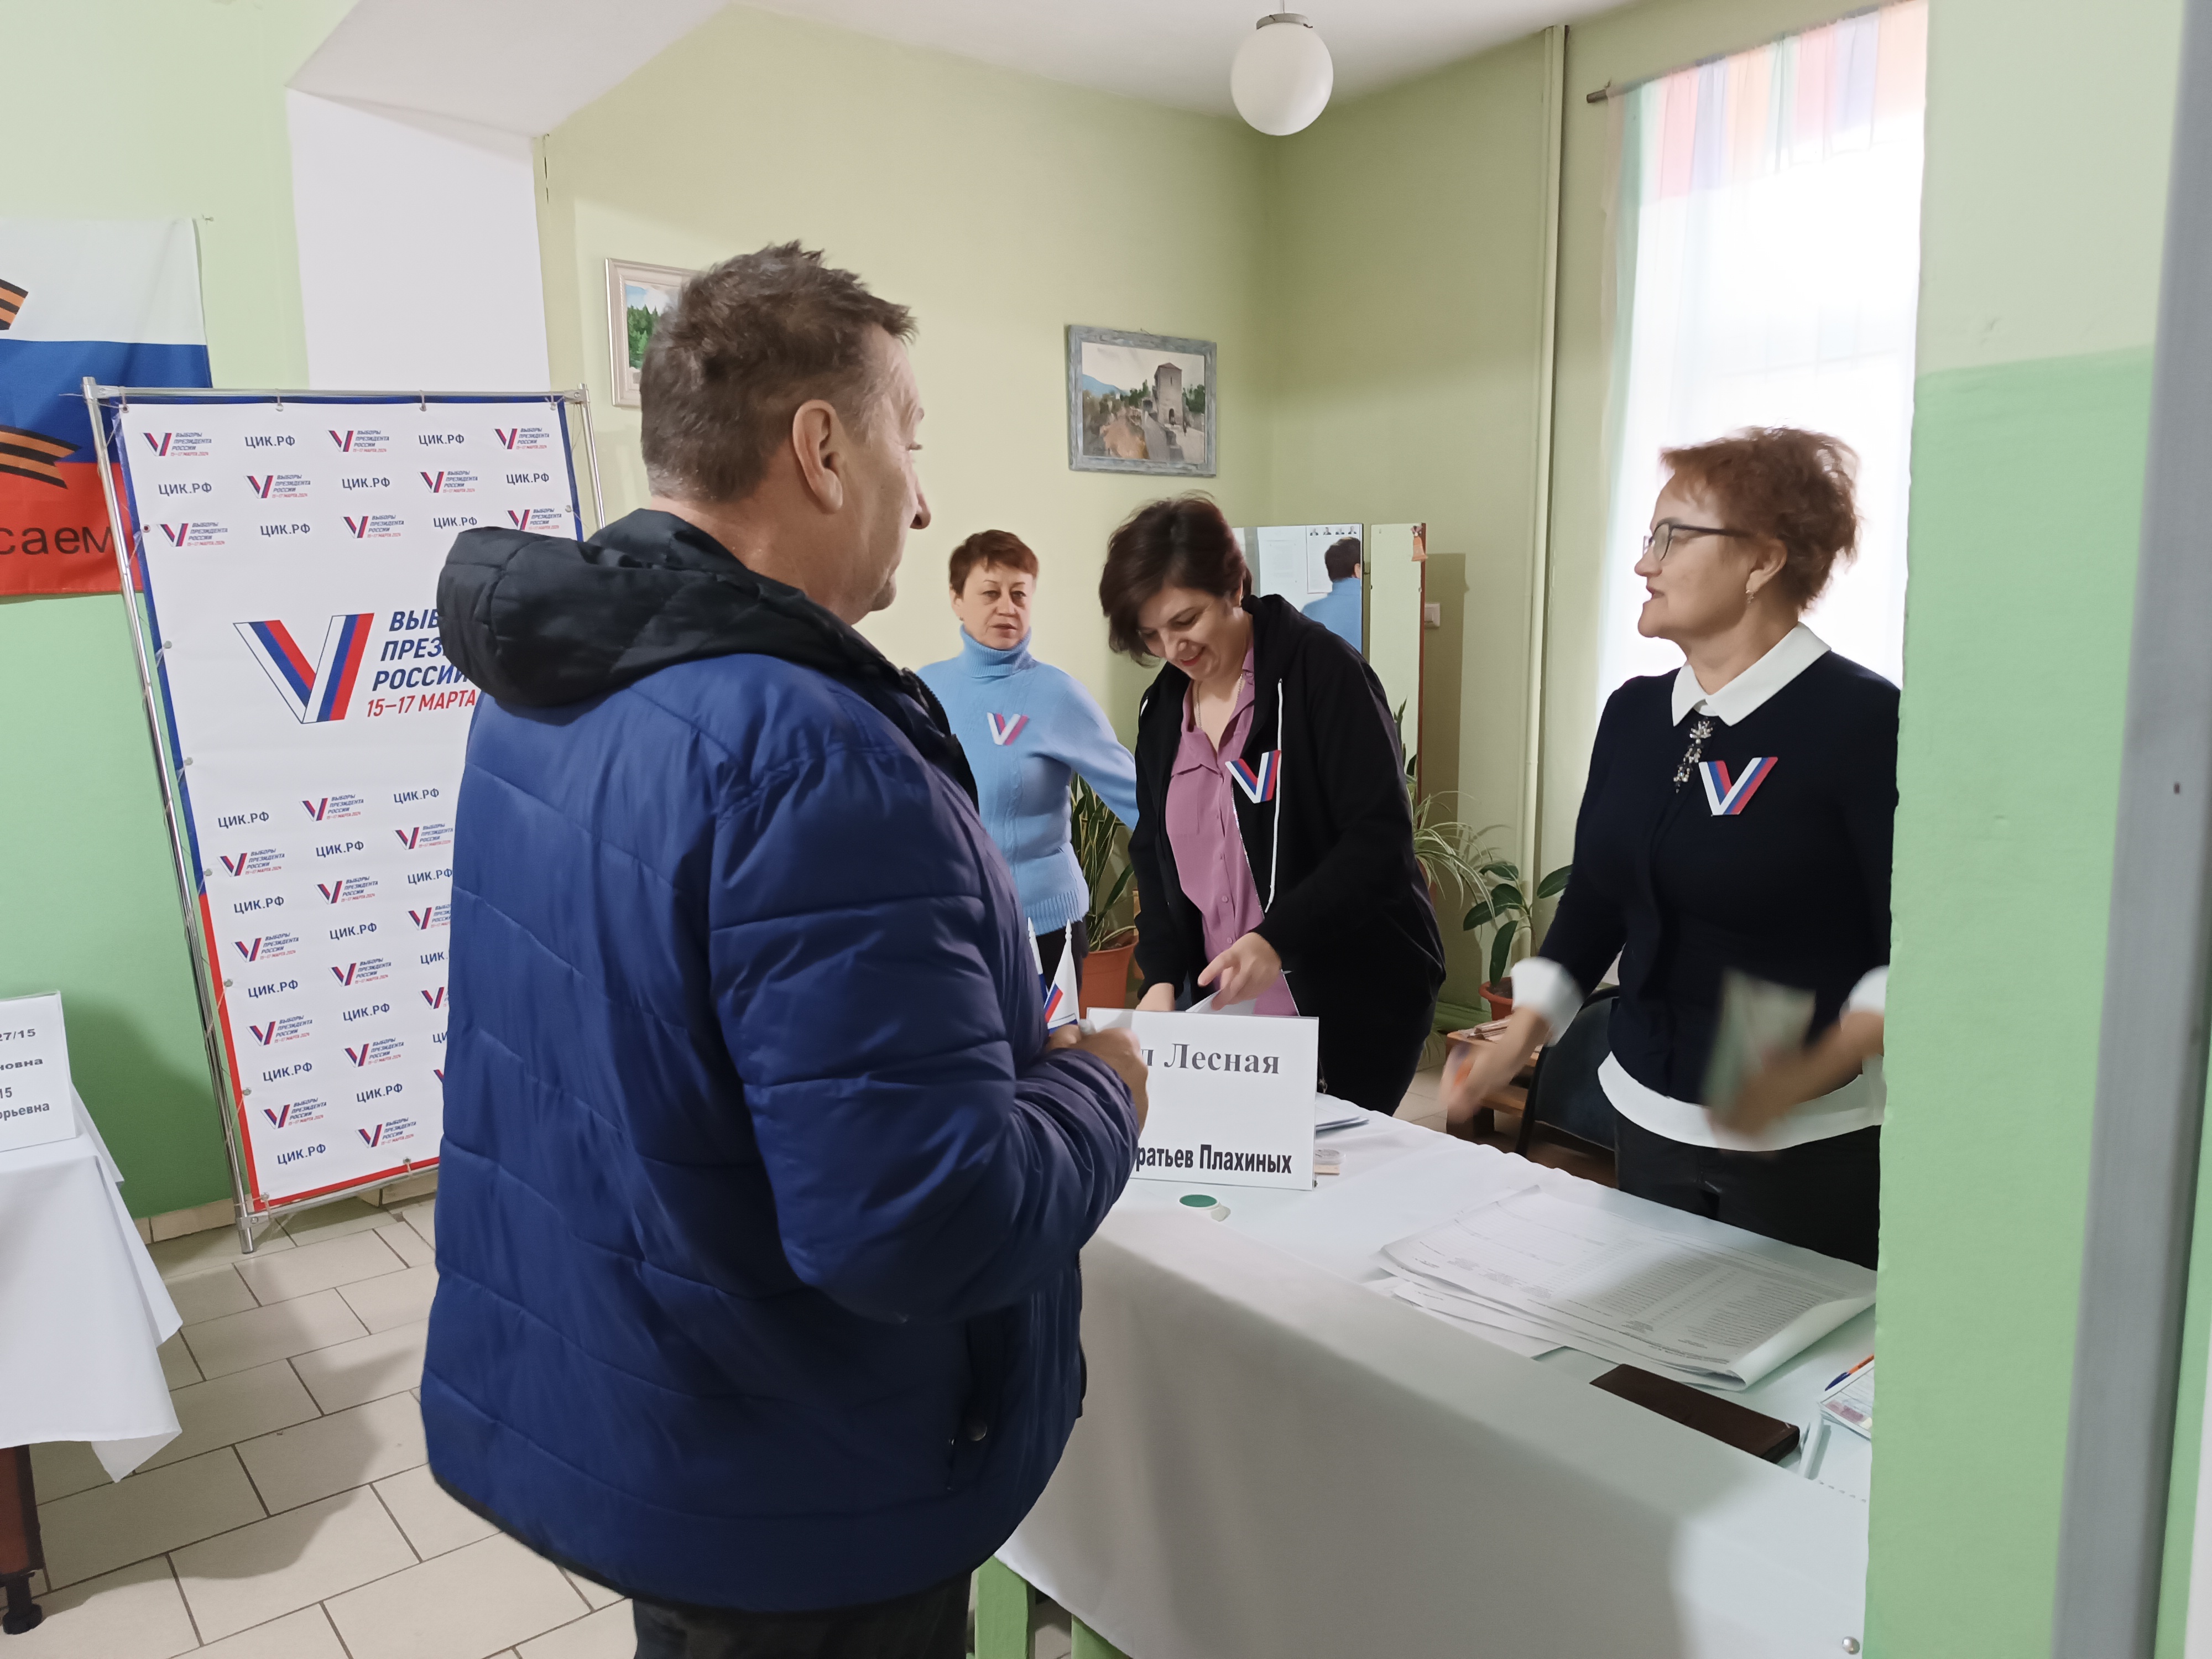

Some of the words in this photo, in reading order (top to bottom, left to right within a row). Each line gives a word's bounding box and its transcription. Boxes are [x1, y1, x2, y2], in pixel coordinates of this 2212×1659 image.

[245, 436, 295, 448] ЦИК.РФ
[419, 434, 464, 446] ЦИК.РФ
[342, 477, 390, 491] ЦИК.РФ
[507, 473, 549, 485] ЦИК.РФ
[159, 483, 211, 496] ЦИК.РФ
[434, 517, 477, 528] ЦИК.РФ
[260, 524, 310, 537] ЦИК.РФ
[389, 609, 439, 632] ВЫБ
[380, 637, 442, 661] ПРЕЗ
[418, 689, 476, 712] МАРТА
[394, 789, 439, 804] ЦИК.РФ
[330, 799, 364, 807] ПРЕЗИДЕНТА
[218, 812, 269, 828] ЦИК.РФ
[316, 841, 363, 858] ЦИК.РФ
[249, 853, 285, 863] ПРЕЗИДЕНТА
[408, 869, 451, 885] ЦИК.РФ
[344, 881, 378, 890] ПРЕЗИДЕНТА
[234, 896, 284, 914] ЦИК.РФ
[265, 932, 290, 941] ВЫБОРЫ
[330, 923, 377, 940] ЦИК.РФ
[263, 937, 299, 947] ПРЕЗИДЕНТА
[262, 946, 284, 954] РОССИИ
[359, 958, 384, 966] ВЫБОРЫ
[420, 952, 448, 964] ЦИК.
[358, 962, 392, 972] ПРЕЗИДЕНТА
[356, 971, 378, 979] РОССИИ
[248, 980, 298, 998] ЦИК.РФ
[343, 1003, 389, 1021] ЦИК.РФ
[278, 1019, 312, 1031] ПРЕЗИДЕНТА
[279, 1015, 304, 1024] ВЫБОРЫ
[0, 1029, 36, 1042] 7/15
[276, 1029, 298, 1037] РОССИИ
[371, 1042, 404, 1053] ПРЕЗИДЕНТА
[372, 1037, 396, 1046] ВЫБОРЫ
[369, 1051, 390, 1060] РОССИИ
[1164, 1044, 1280, 1074] Лесная
[263, 1062, 312, 1082] ЦИК.РФ
[357, 1084, 402, 1103] ЦИК.РФ
[291, 1102, 327, 1113] ПРЕЗИДЕНТА
[293, 1098, 319, 1107] ВЫБОРЫ
[290, 1111, 312, 1120] РОССИИ
[385, 1117, 409, 1126] ВЫБОРЫ
[384, 1121, 416, 1133] ПРЕЗИДЕНТА
[382, 1130, 403, 1140] РОССИИ
[278, 1144, 326, 1165] ЦИК.РФ
[1136, 1146, 1193, 1172] ратьев
[1199, 1144, 1292, 1173] Плахиных
